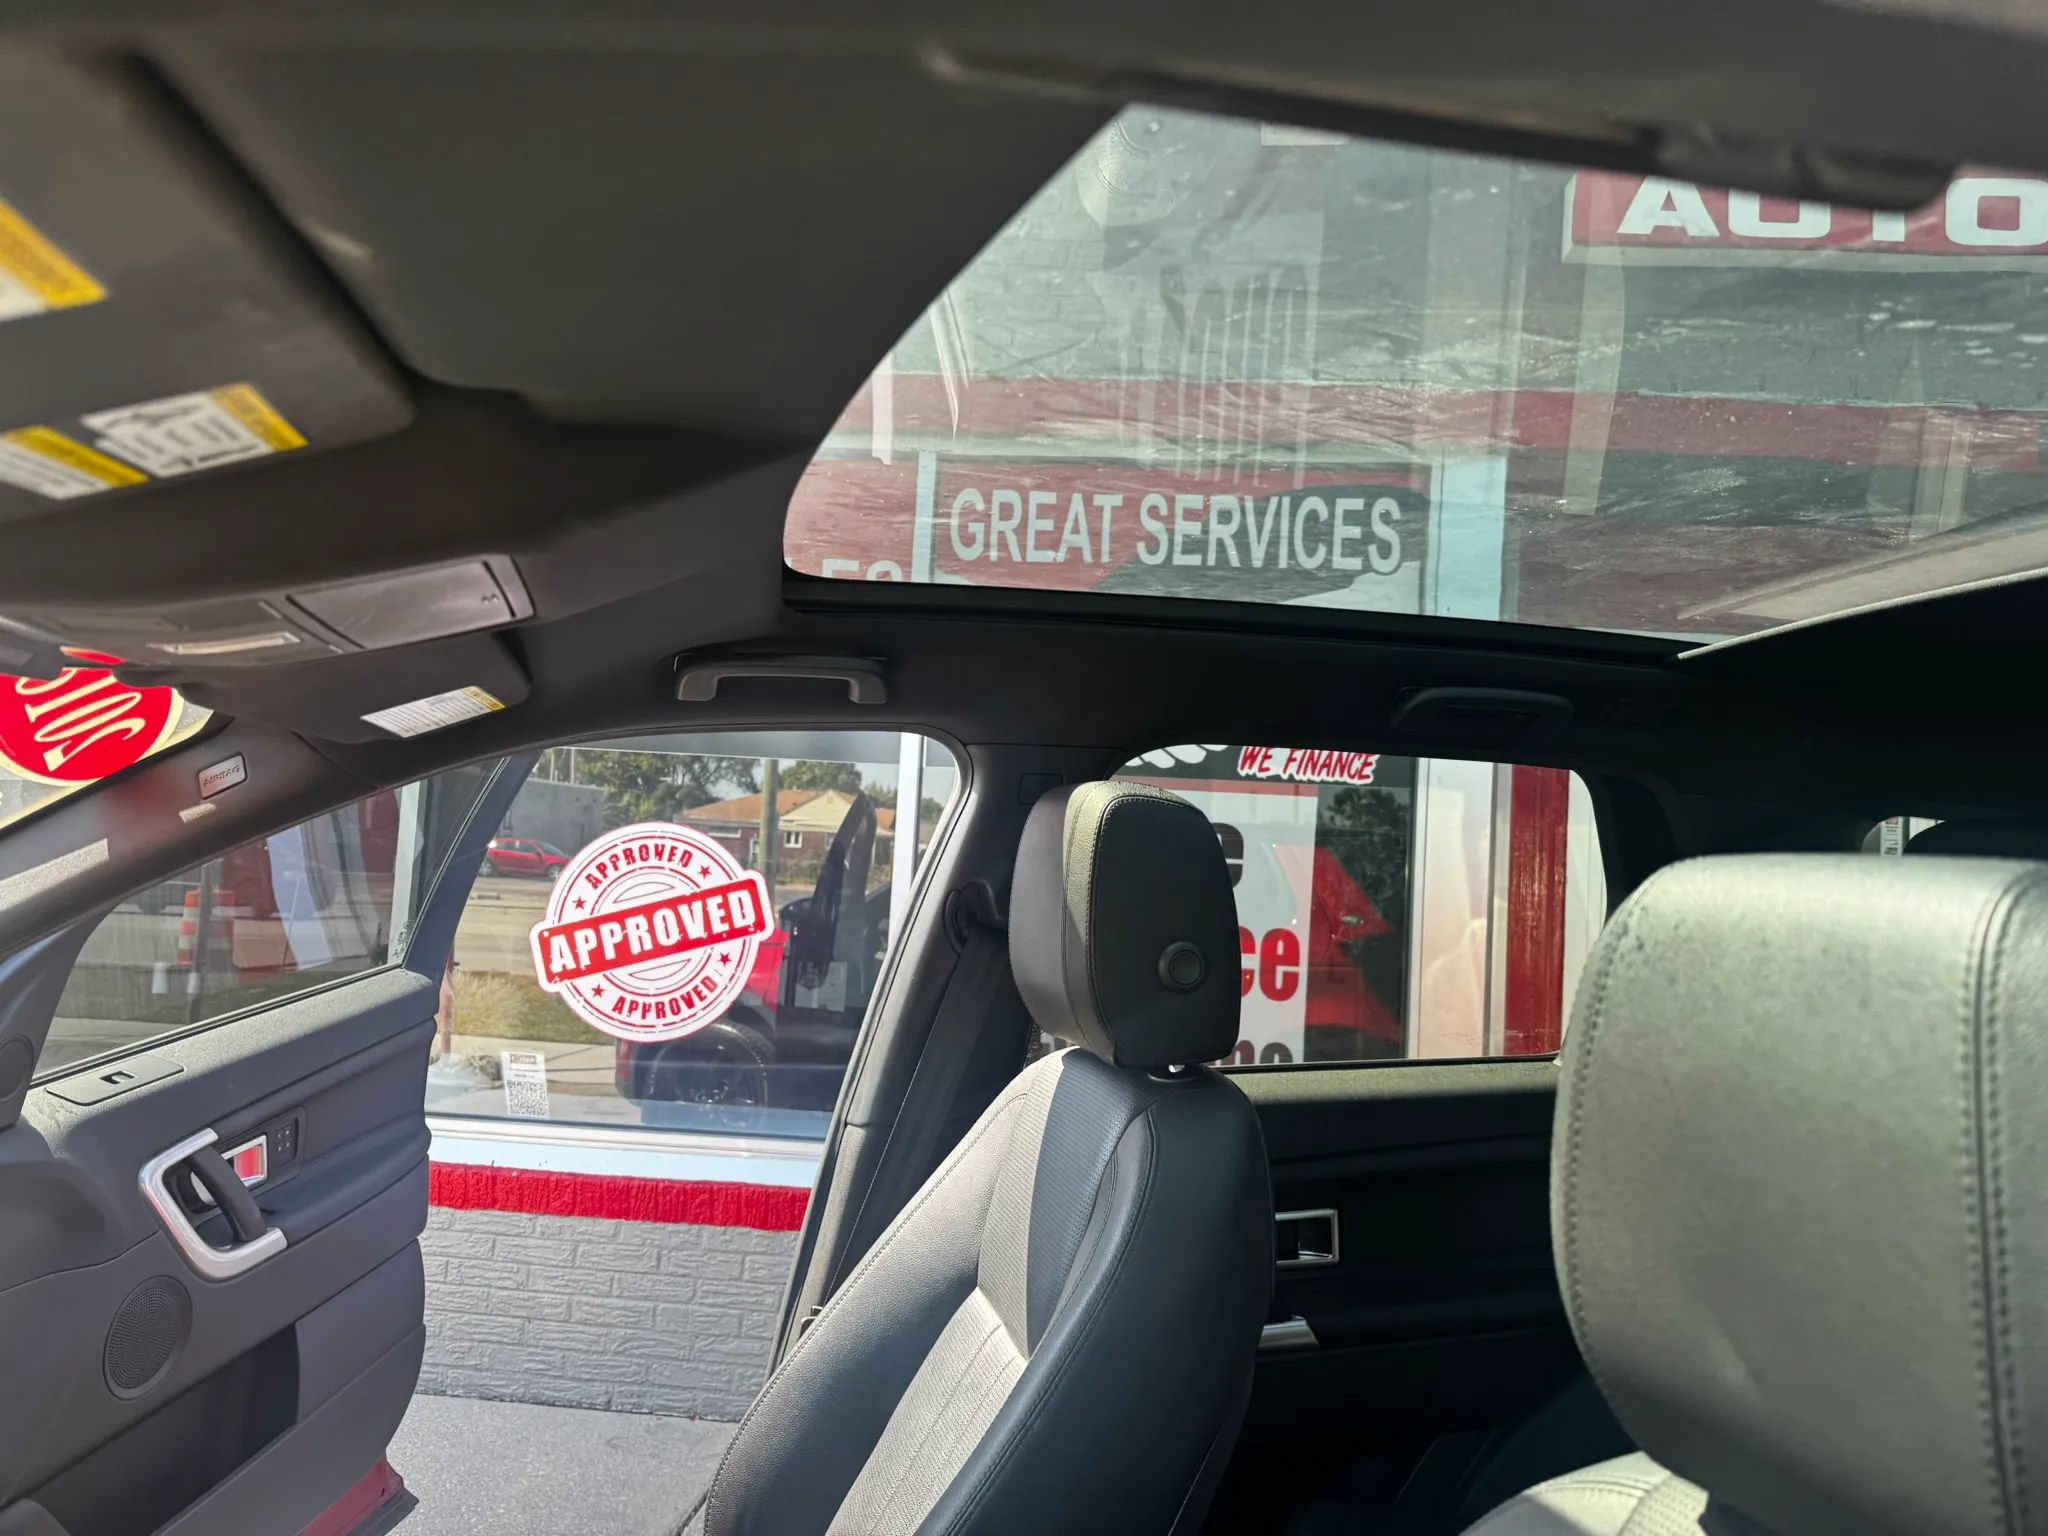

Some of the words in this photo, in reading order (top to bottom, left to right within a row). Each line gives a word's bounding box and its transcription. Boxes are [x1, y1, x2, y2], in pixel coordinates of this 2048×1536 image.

[950, 487, 1123, 563] GREAT
[1136, 492, 1402, 574] SERVICES
[202, 764, 241, 788] AIRBAG
[1239, 745, 1273, 774] WE
[1282, 747, 1375, 781] FINANCE
[585, 843, 694, 890] APPROVED
[551, 889, 757, 974] APPROVED
[611, 975, 718, 1020] APPROVED
